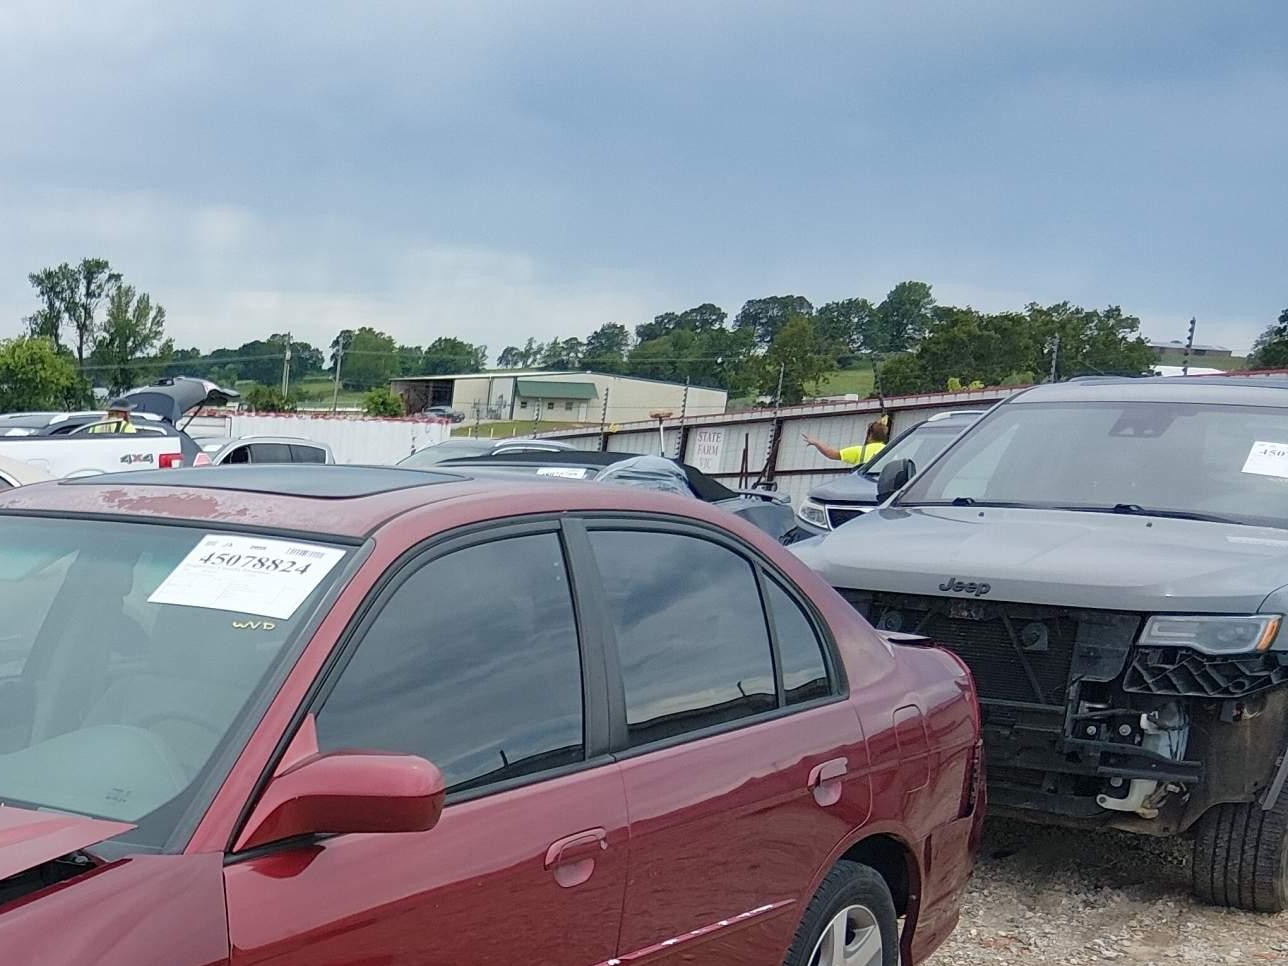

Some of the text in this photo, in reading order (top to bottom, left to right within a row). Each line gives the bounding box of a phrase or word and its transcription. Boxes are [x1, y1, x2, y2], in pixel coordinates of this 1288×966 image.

[697, 431, 722, 443] STATE
[697, 444, 719, 457] FARM
[199, 551, 313, 575] 45078824
[938, 576, 992, 597] Jeep
